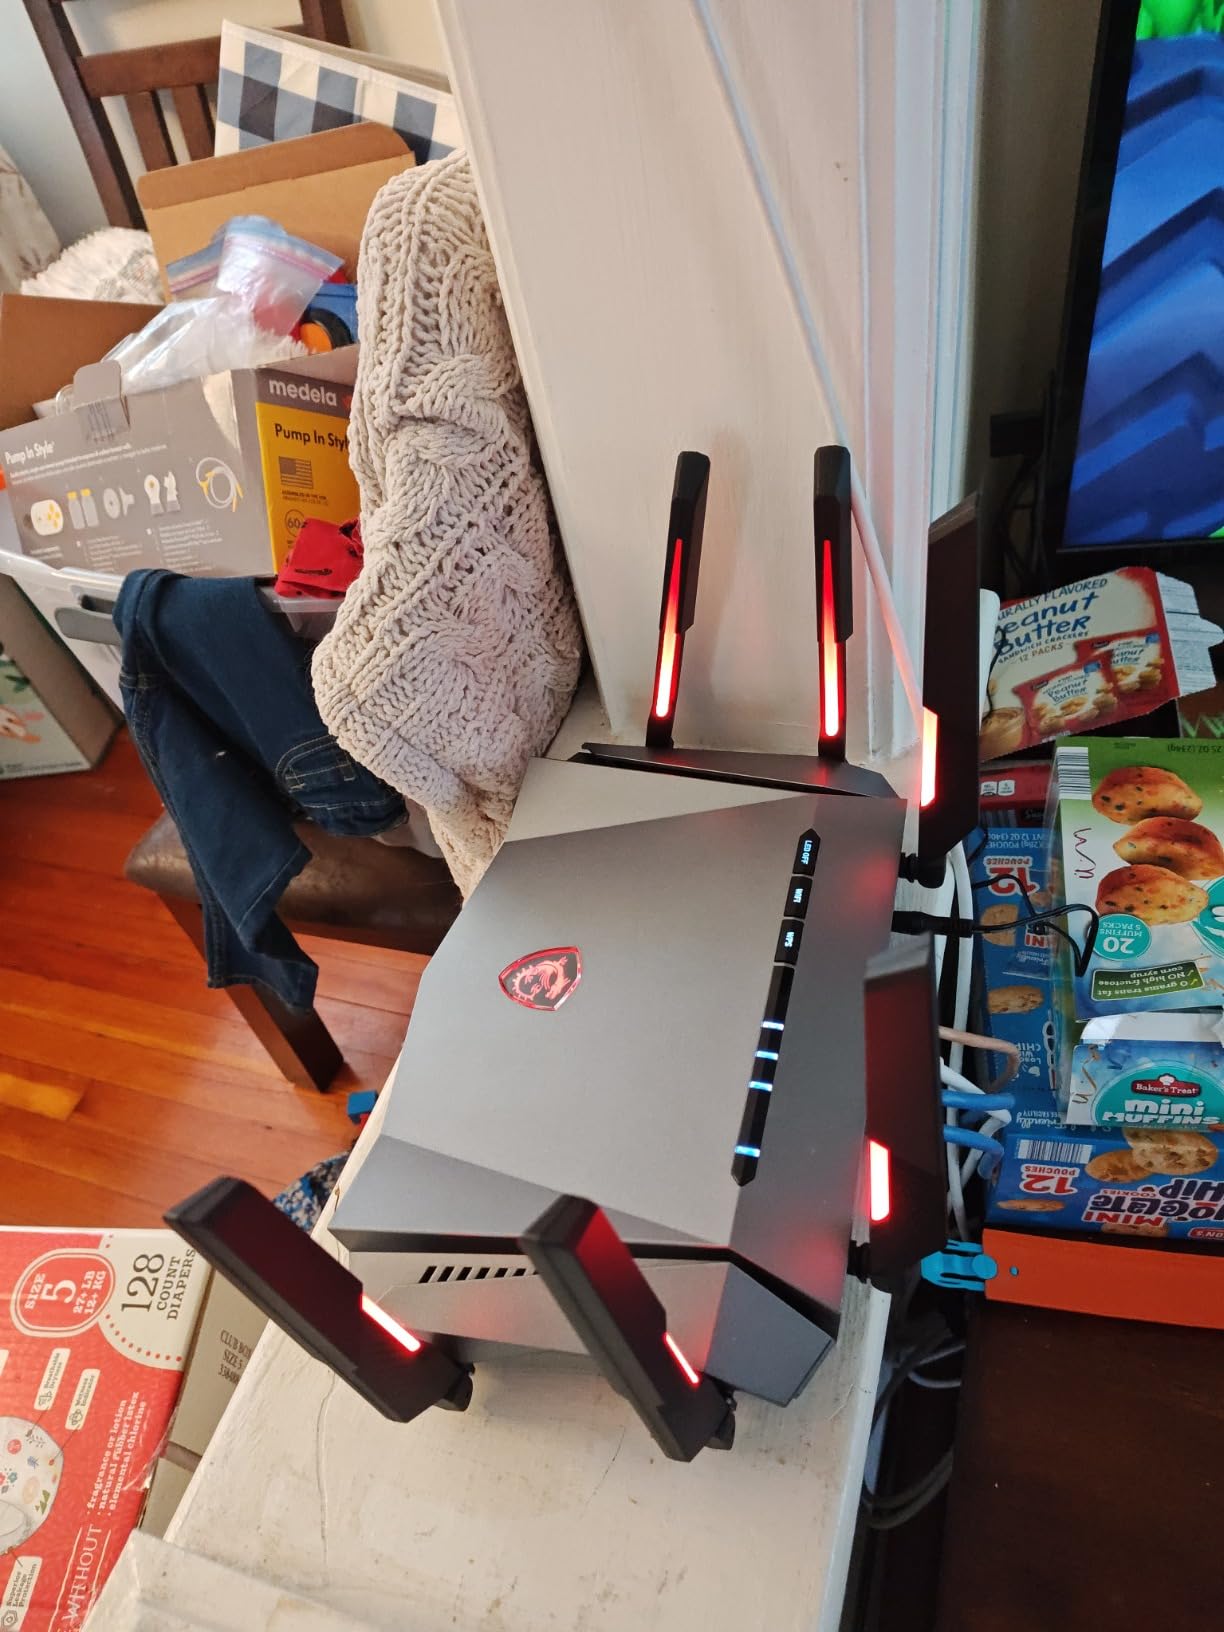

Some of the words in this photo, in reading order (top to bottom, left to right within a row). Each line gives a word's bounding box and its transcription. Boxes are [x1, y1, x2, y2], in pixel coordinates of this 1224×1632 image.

[269, 380, 337, 406] medela
[275, 423, 311, 446] Pump
[313, 429, 325, 445] In
[327, 432, 350, 452] Styl
[5, 451, 26, 465] Pump
[25, 446, 35, 459] In
[287, 517, 301, 529] 60
[998, 597, 1041, 620] URALLY
[1044, 578, 1108, 602] FLAVORED
[1002, 591, 1099, 634] eanut
[999, 640, 1042, 664] SANDWICH
[1045, 630, 1089, 645] CRACKERS
[1019, 653, 1030, 664] 12
[1032, 642, 1064, 657] PACKS
[803, 839, 812, 852] LED
[986, 841, 1019, 849] POUCHE
[801, 851, 811, 865] OFF
[986, 857, 1030, 865] POUCHES
[990, 867, 1037, 894] 12
[1100, 928, 1143, 937] MUFFINS
[1103, 922, 1134, 930] PACKS
[784, 931, 795, 947] WPS
[1102, 936, 1136, 954] 20
[1130, 970, 1158, 979] syrup
[1142, 975, 1166, 984] high
[1161, 966, 1184, 974] corn
[1167, 972, 1186, 980] NO
[1098, 978, 1140, 987] fructose
[1144, 982, 1178, 992] grams
[1136, 1083, 1170, 1092] Baker's
[1170, 1086, 1197, 1094] Treat
[1124, 1098, 1205, 1116] mini
[1101, 1111, 1221, 1126] MUFFINS
[1024, 1165, 1076, 1176] POUCHES
[1023, 1173, 1074, 1194] 12
[1103, 1189, 1156, 1197] COOKIES
[1083, 1211, 1163, 1226] MINI
[24, 1272, 46, 1310] SIZE
[40, 1279, 77, 1304] 5
[73, 1292, 88, 1314] 27+
[81, 1270, 95, 1289] LB
[84, 1293, 99, 1314] 12+
[92, 1270, 107, 1290] KG
[121, 1253, 165, 1313] 128
[156, 1256, 181, 1311] COUNT
[166, 1248, 197, 1320] DIAPERS
[109, 1400, 127, 1434] lotion
[99, 1463, 118, 1509] natural
[112, 1423, 130, 1461] rubber
[123, 1391, 140, 1421] latex
[107, 1435, 116, 1448] or
[109, 1451, 131, 1511] elemental
[127, 1401, 147, 1449] chlorine
[87, 1450, 111, 1509] fragrance
[61, 1523, 103, 1621] WITHOUT
[6, 1571, 22, 1607] Superior
[12, 1574, 27, 1607] Leakage
[18, 1563, 37, 1607] Protection
